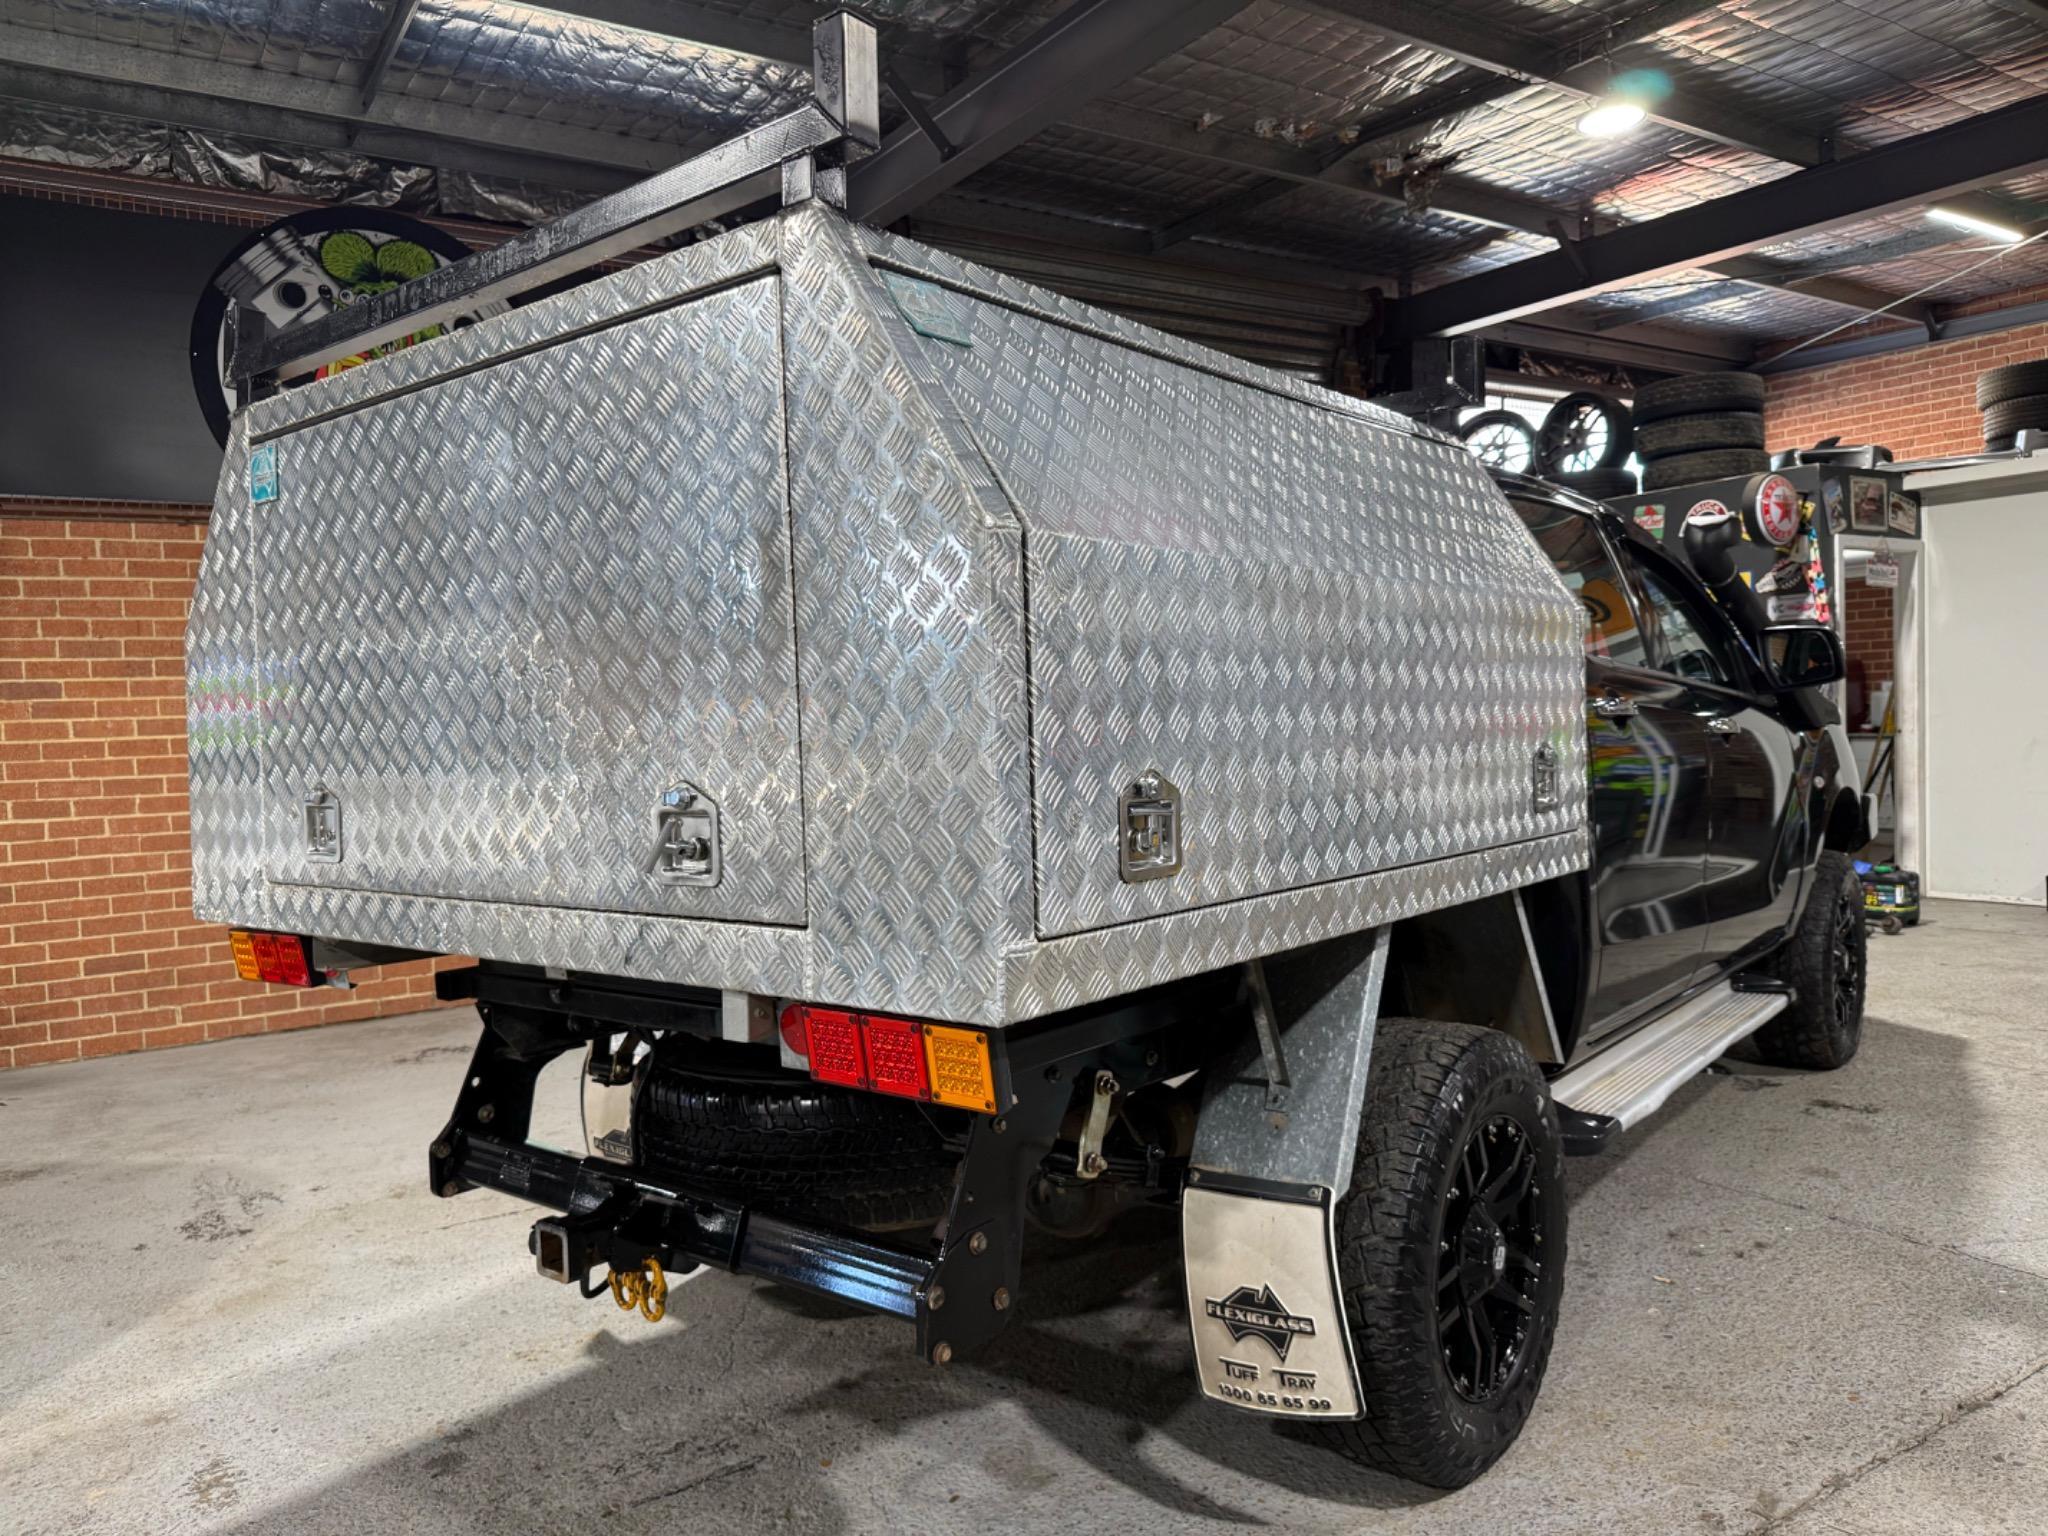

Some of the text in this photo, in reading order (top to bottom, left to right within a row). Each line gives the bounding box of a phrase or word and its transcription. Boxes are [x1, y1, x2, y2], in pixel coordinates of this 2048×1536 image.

[1206, 1302, 1314, 1332] FLEXIGLASS
[1219, 1357, 1316, 1390] TUFF TRAY
[1218, 1383, 1253, 1402] 1300
[1308, 1398, 1332, 1410] 99
